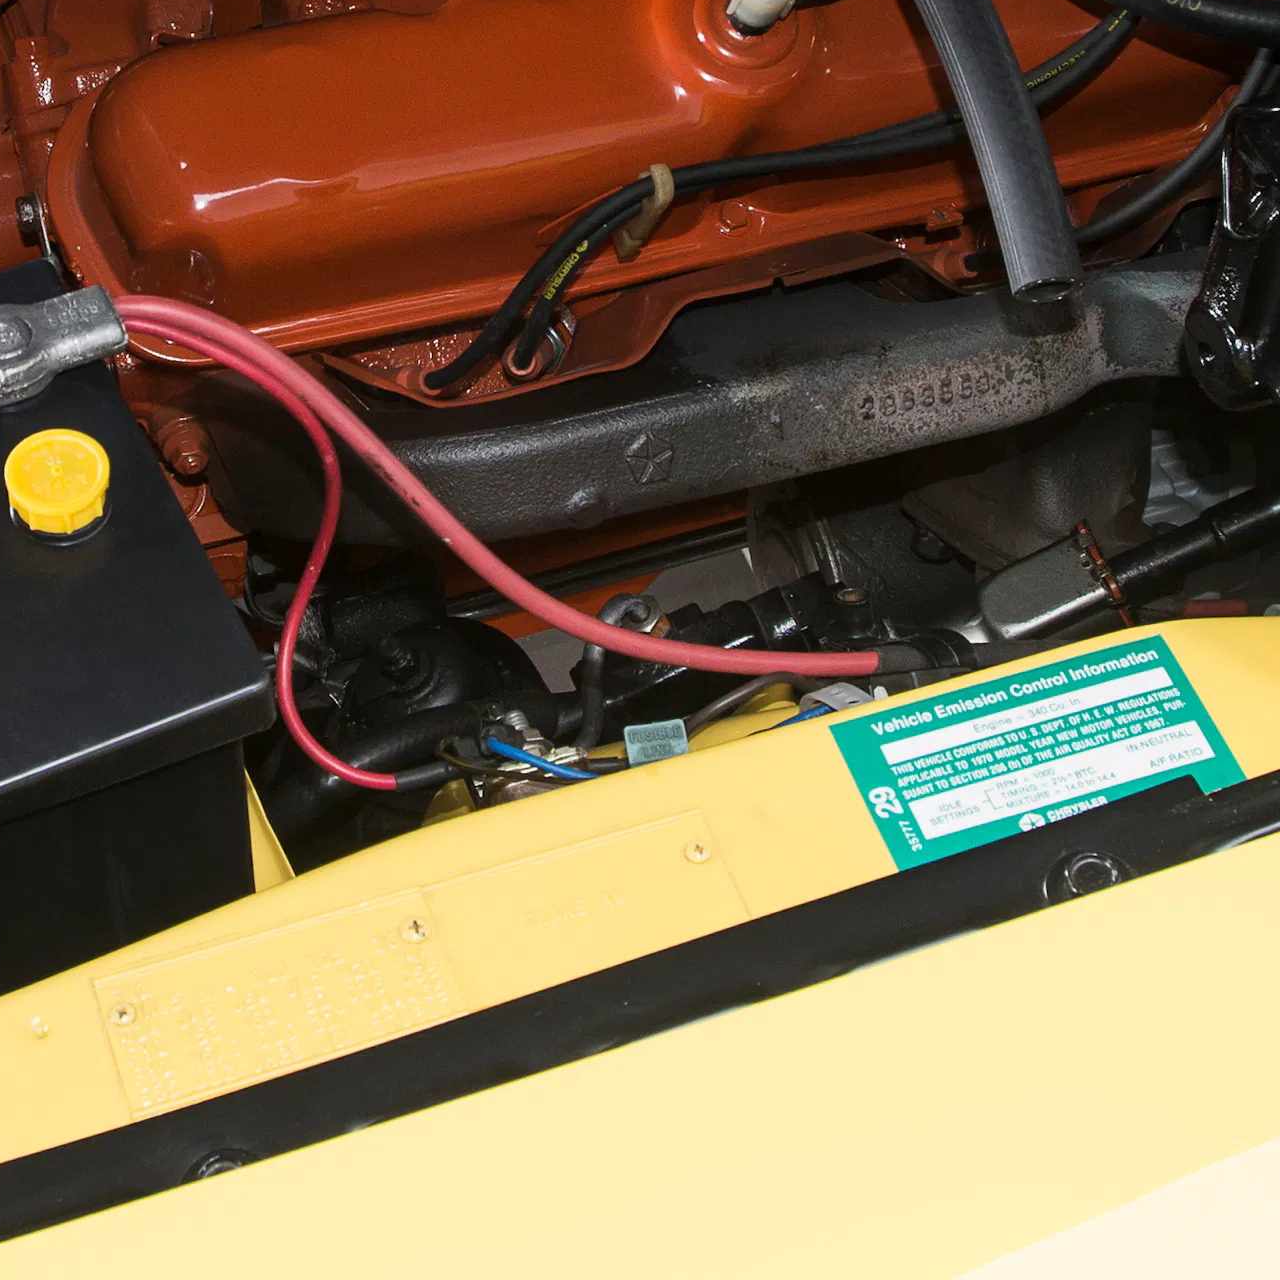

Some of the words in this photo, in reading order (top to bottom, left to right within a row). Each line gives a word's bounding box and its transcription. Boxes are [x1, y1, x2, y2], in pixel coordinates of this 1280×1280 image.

[1025, 49, 1087, 90] ELECTRONIC
[543, 252, 580, 301] CHRYSLER
[869, 707, 935, 737] Vehicle
[932, 686, 1009, 719] Emission
[1007, 670, 1070, 698] Control
[1067, 645, 1160, 682] Information
[628, 725, 683, 745] FUSIBLE
[889, 761, 915, 776] THIS
[912, 750, 954, 770] VEHICLE
[951, 735, 1006, 759] CONFORMS
[1003, 731, 1020, 744] TO
[1016, 728, 1031, 740] U.
[1028, 725, 1042, 737] S.
[1039, 717, 1070, 734] DEPT.
[1067, 713, 1083, 725] OF
[1080, 710, 1094, 722] H.
[1092, 707, 1105, 718] E.
[1102, 704, 1119, 716] W.
[1116, 686, 1182, 712] REGULATIONS
[971, 714, 1014, 735] Engine
[1026, 705, 1049, 718] 340
[1048, 699, 1069, 712] Cu.
[1067, 695, 1084, 707] In.
[895, 763, 955, 788] APPLICABLE
[953, 759, 970, 771] TO
[969, 752, 995, 767] 1970
[993, 742, 1029, 760] MODEL
[1027, 734, 1056, 750] YEAR
[1054, 728, 1080, 743] NEW
[1078, 718, 1116, 736] MOTOR
[1113, 705, 1163, 726] VEHICLES,
[1161, 698, 1188, 712] PUR-
[901, 782, 936, 800] SUANT
[933, 778, 950, 791] TO
[947, 766, 991, 787] SECTION
[1019, 754, 1035, 766] OF
[1033, 748, 1056, 762] THE
[1051, 742, 1073, 756] AIR
[1069, 731, 1113, 751] QUALITY
[1109, 726, 1131, 740] ACT
[1128, 722, 1145, 735] OF
[1142, 715, 1170, 731] 1967.
[994, 777, 1020, 790] RPM
[1031, 766, 1057, 780] 1000
[1124, 742, 1140, 753] IN
[1138, 727, 1193, 749] NEUTRAL
[999, 783, 1039, 801] TIMING
[1073, 766, 1097, 779] BTC
[1004, 790, 1051, 809] MIXTURE
[1146, 756, 1168, 769] A/F
[1167, 746, 1204, 763] RATIO
[864, 783, 906, 821] 29
[928, 804, 982, 826] SETTINGS
[937, 799, 964, 813] IDLE
[1044, 794, 1111, 823] CHRYSLER
